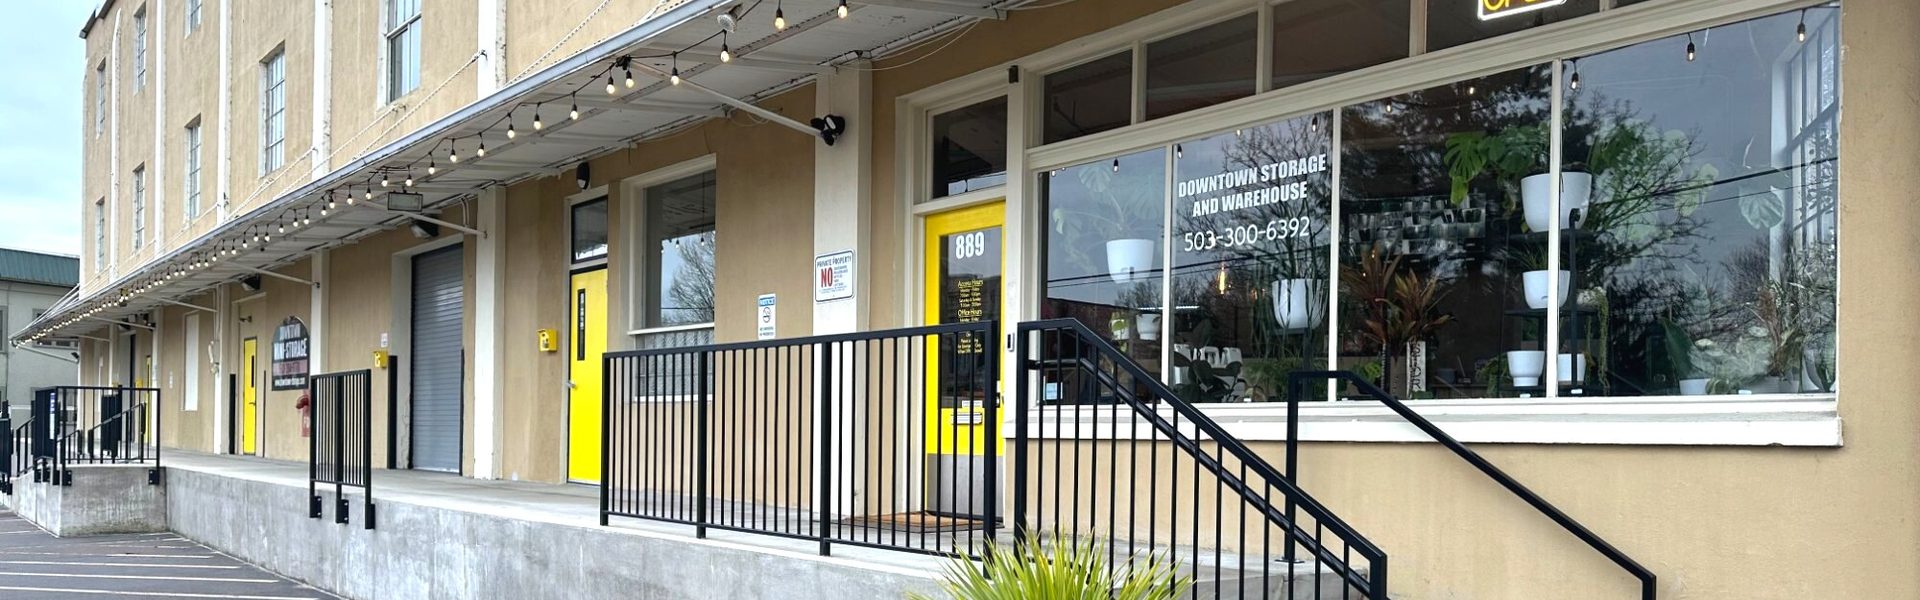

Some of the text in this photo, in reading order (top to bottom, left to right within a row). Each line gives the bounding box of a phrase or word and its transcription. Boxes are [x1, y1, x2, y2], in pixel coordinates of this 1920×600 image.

[1178, 153, 1327, 198] DOWNTOWN STORAGE
[1192, 181, 1308, 218] AND WAREHOUSE
[956, 232, 984, 259] 889
[1184, 216, 1310, 252] 503-300-6392
[821, 266, 833, 289] NO
